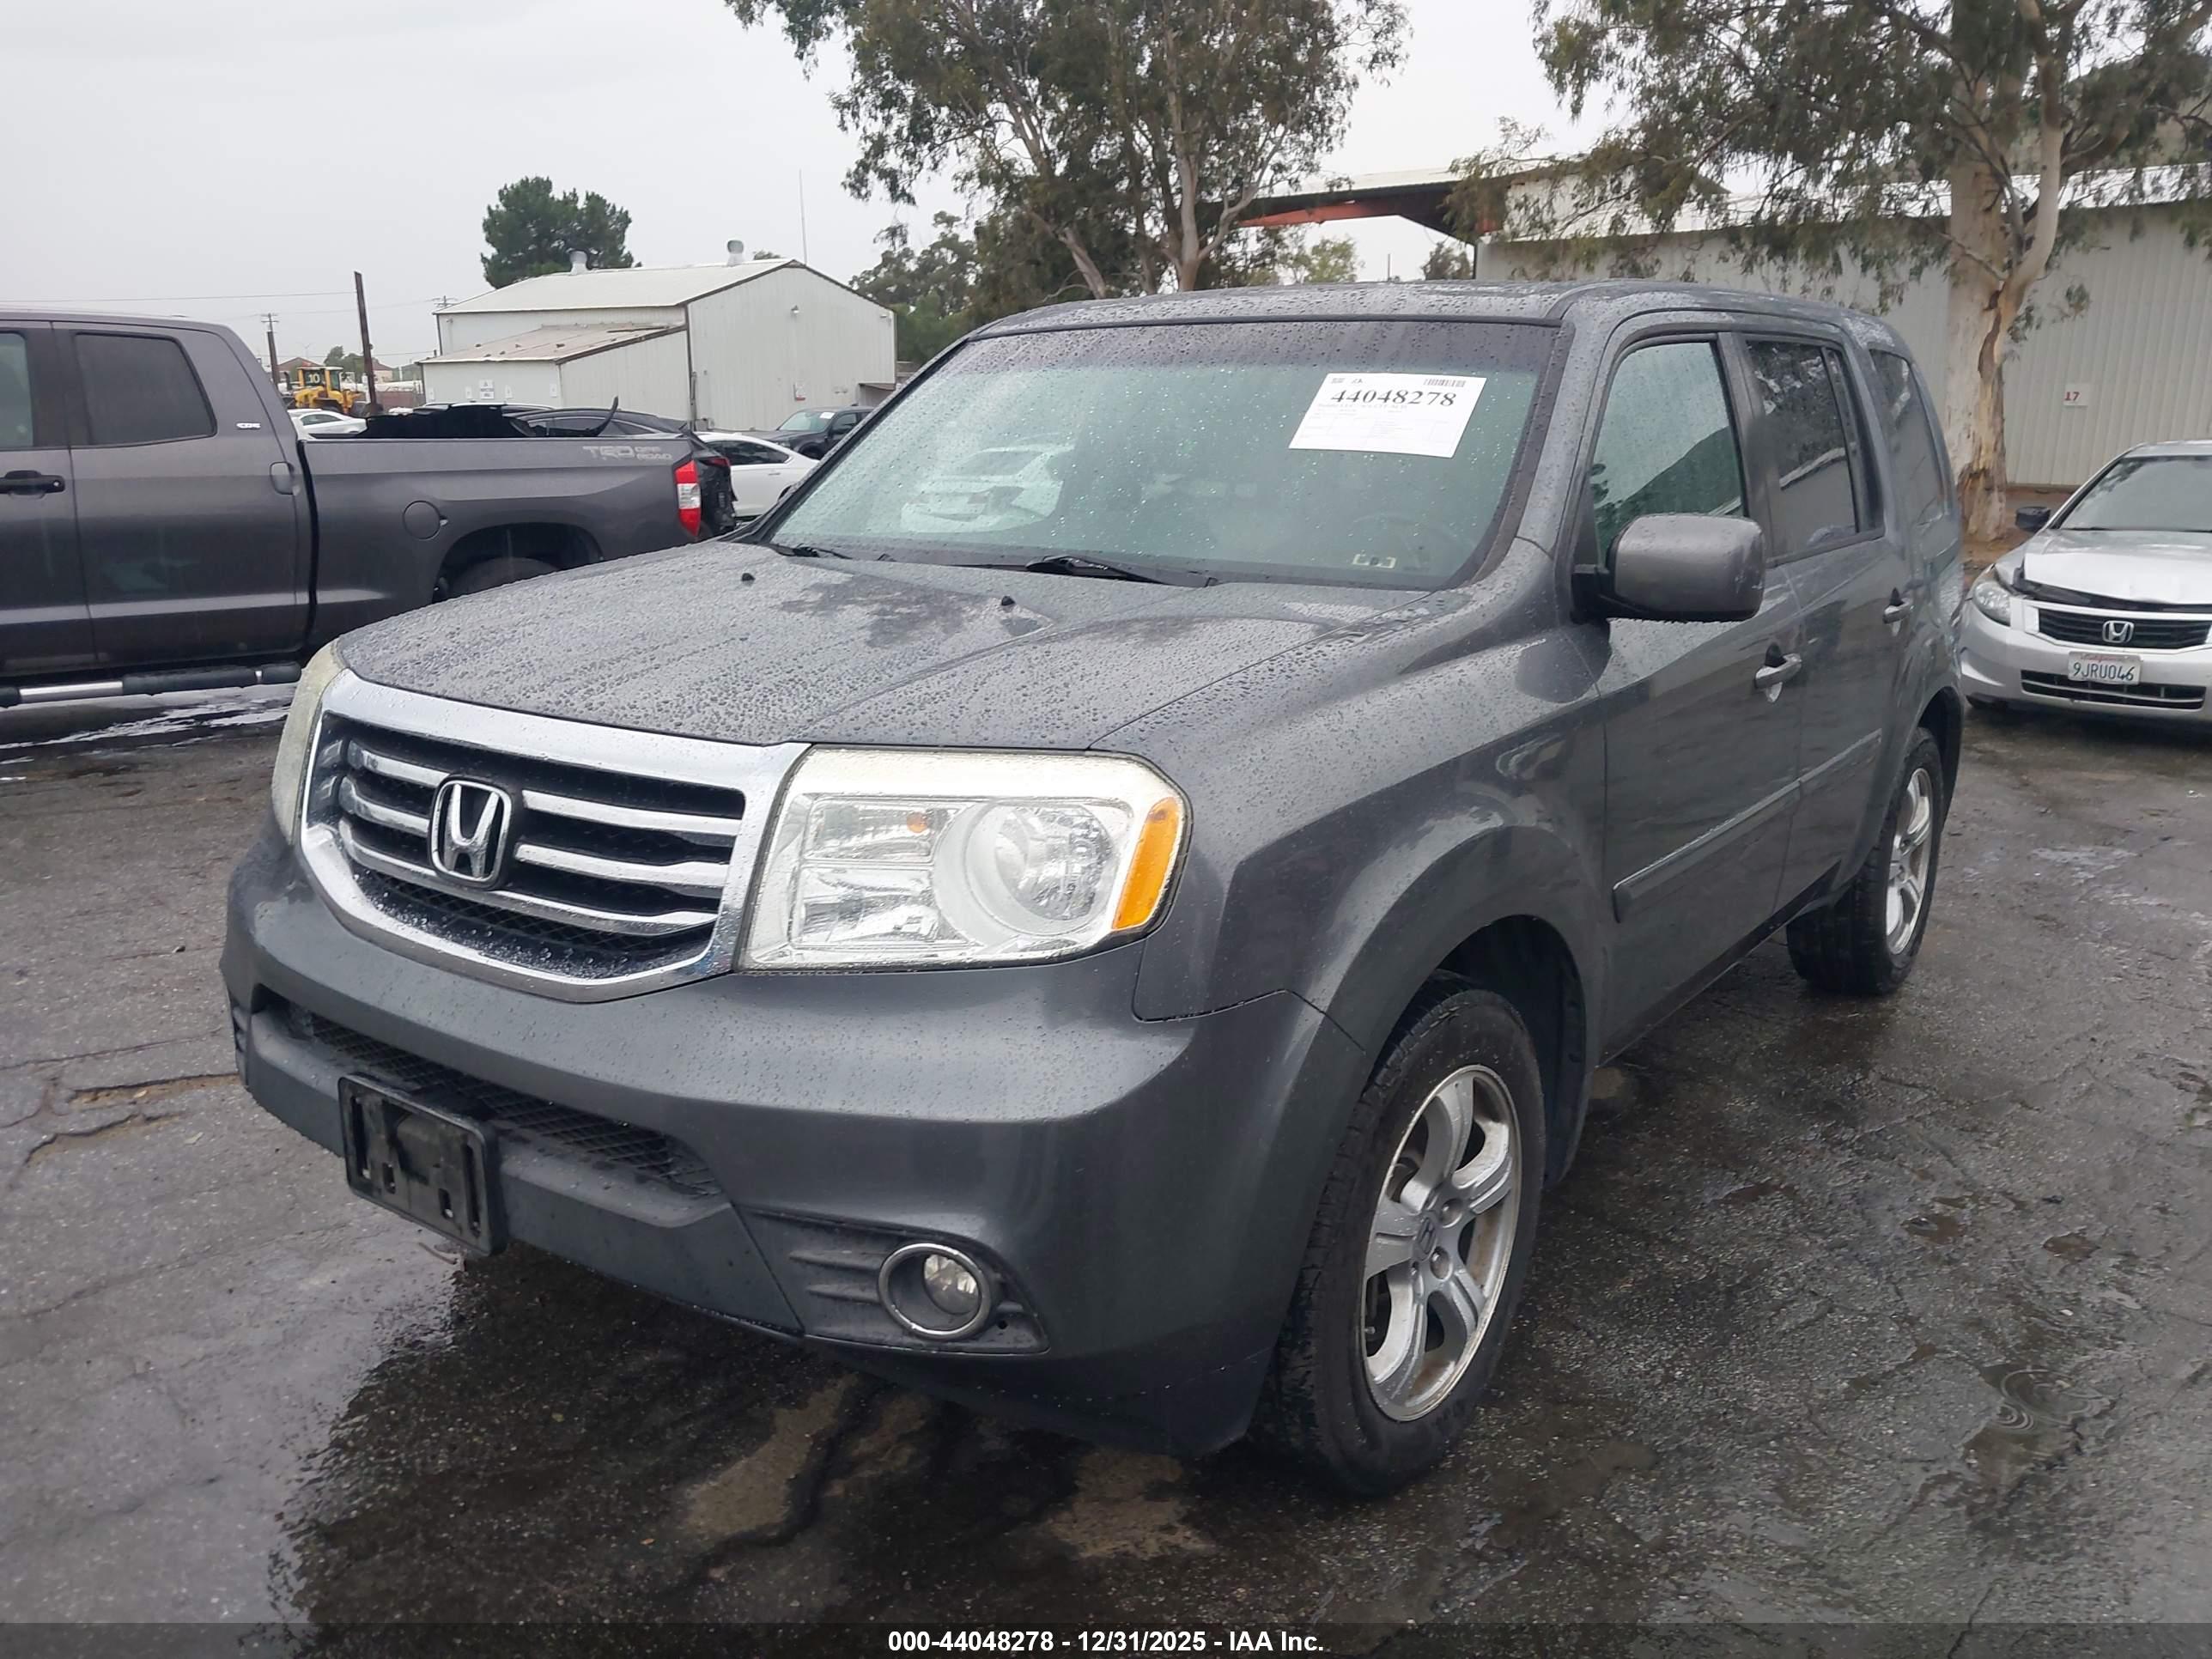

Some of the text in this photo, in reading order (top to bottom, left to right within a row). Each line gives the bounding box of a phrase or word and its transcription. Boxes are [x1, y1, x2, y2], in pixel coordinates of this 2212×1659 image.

[1331, 389, 1457, 407] 44048278
[2064, 391, 2081, 402] 17
[2073, 661, 2136, 682] 9JRU046
